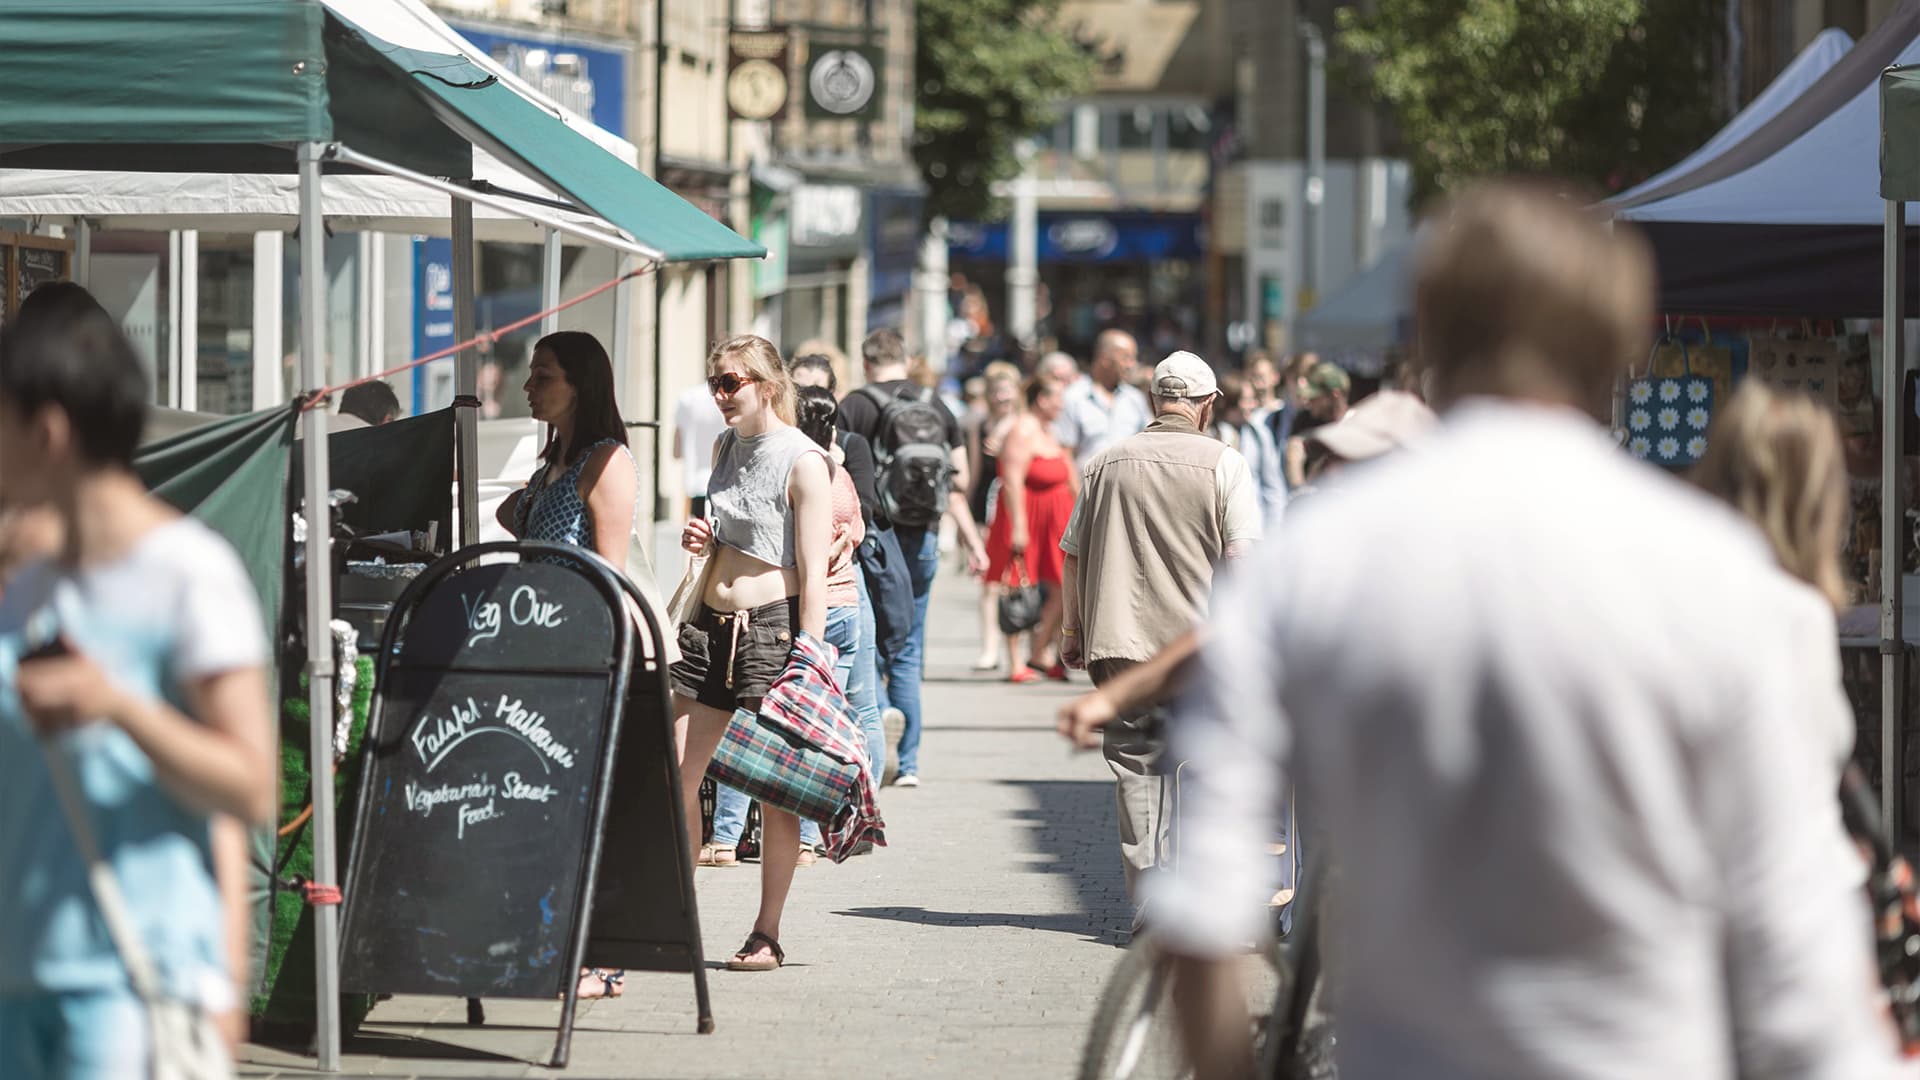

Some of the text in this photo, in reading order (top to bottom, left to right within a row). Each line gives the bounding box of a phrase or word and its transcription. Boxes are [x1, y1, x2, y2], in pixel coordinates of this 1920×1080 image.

[462, 590, 501, 647] Veg
[411, 697, 481, 764] Falafel
[405, 771, 558, 817] Vegetarian Street
